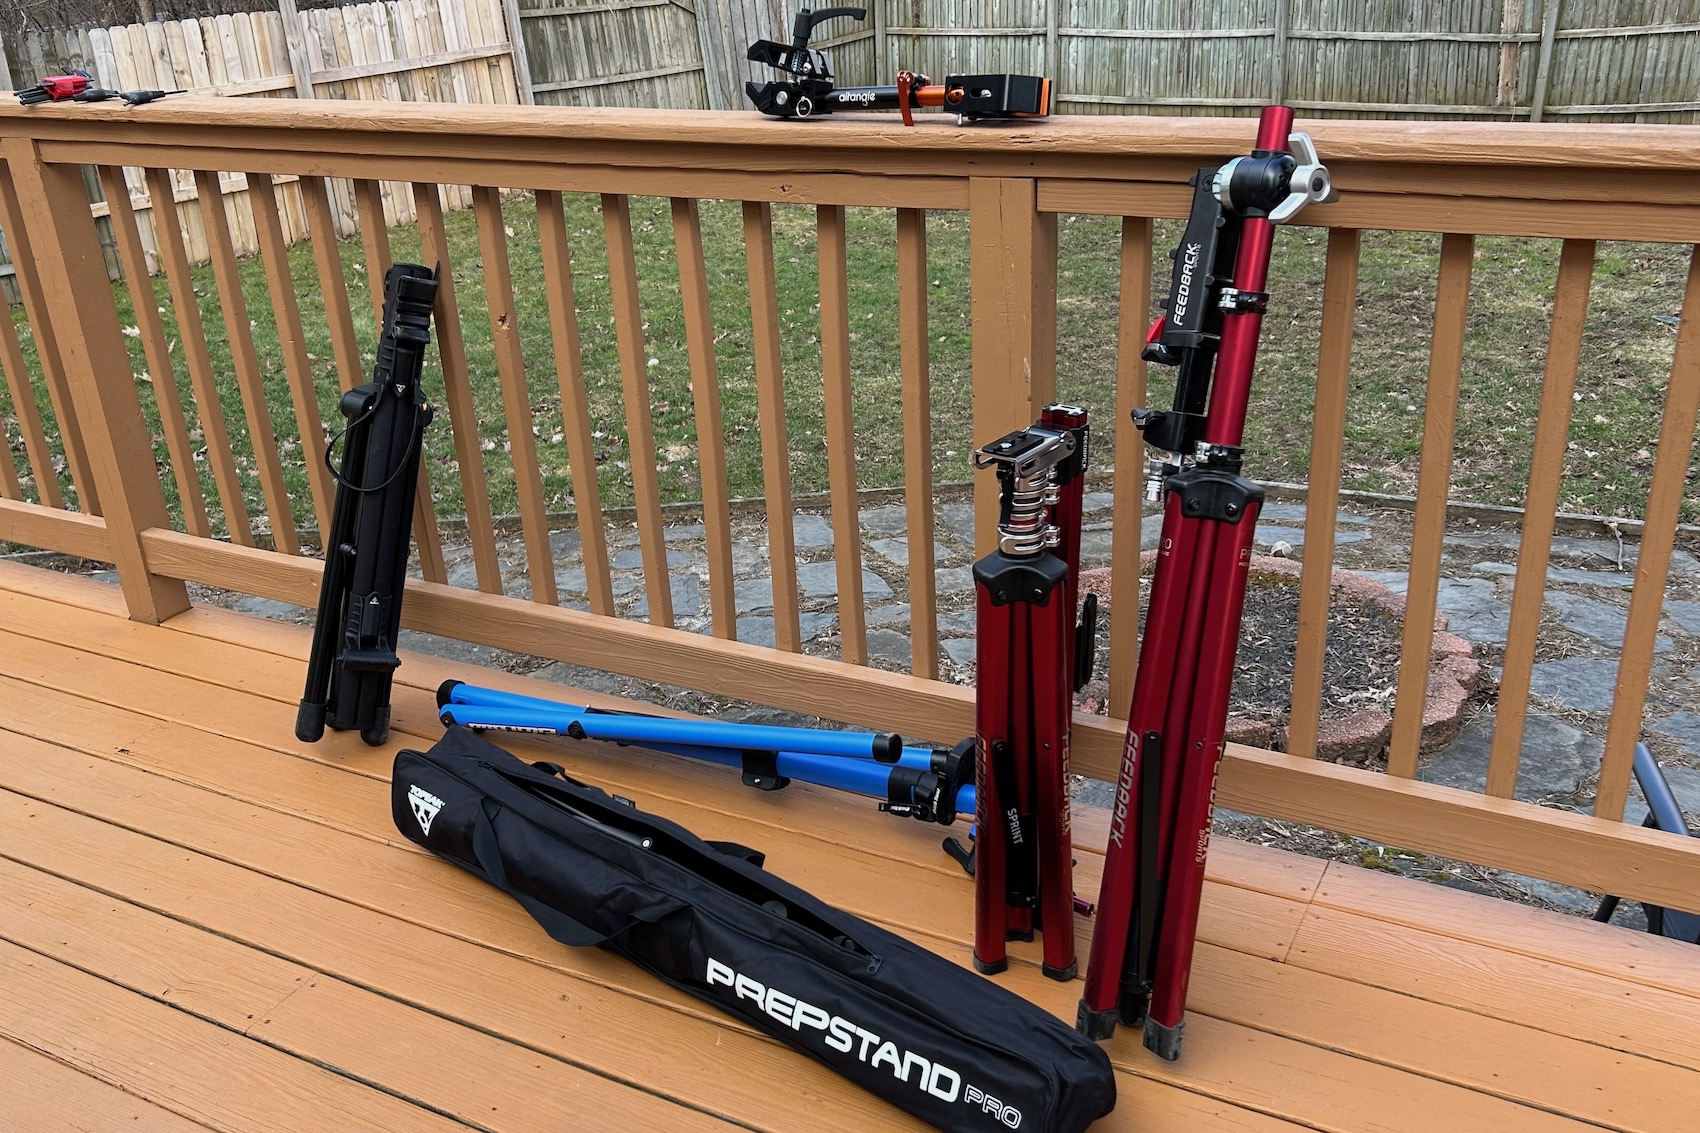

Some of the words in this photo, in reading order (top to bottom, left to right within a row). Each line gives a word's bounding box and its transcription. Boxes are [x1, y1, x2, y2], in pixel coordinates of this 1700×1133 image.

[838, 91, 876, 107] altangle
[1173, 243, 1197, 326] FEEDBACK
[1110, 728, 1139, 848] FEEDBACK
[1007, 808, 1024, 844] SPRINT
[1195, 829, 1206, 863] SPORTS
[706, 957, 961, 1103] PREPSTAND
[964, 1084, 1022, 1130] PRO
